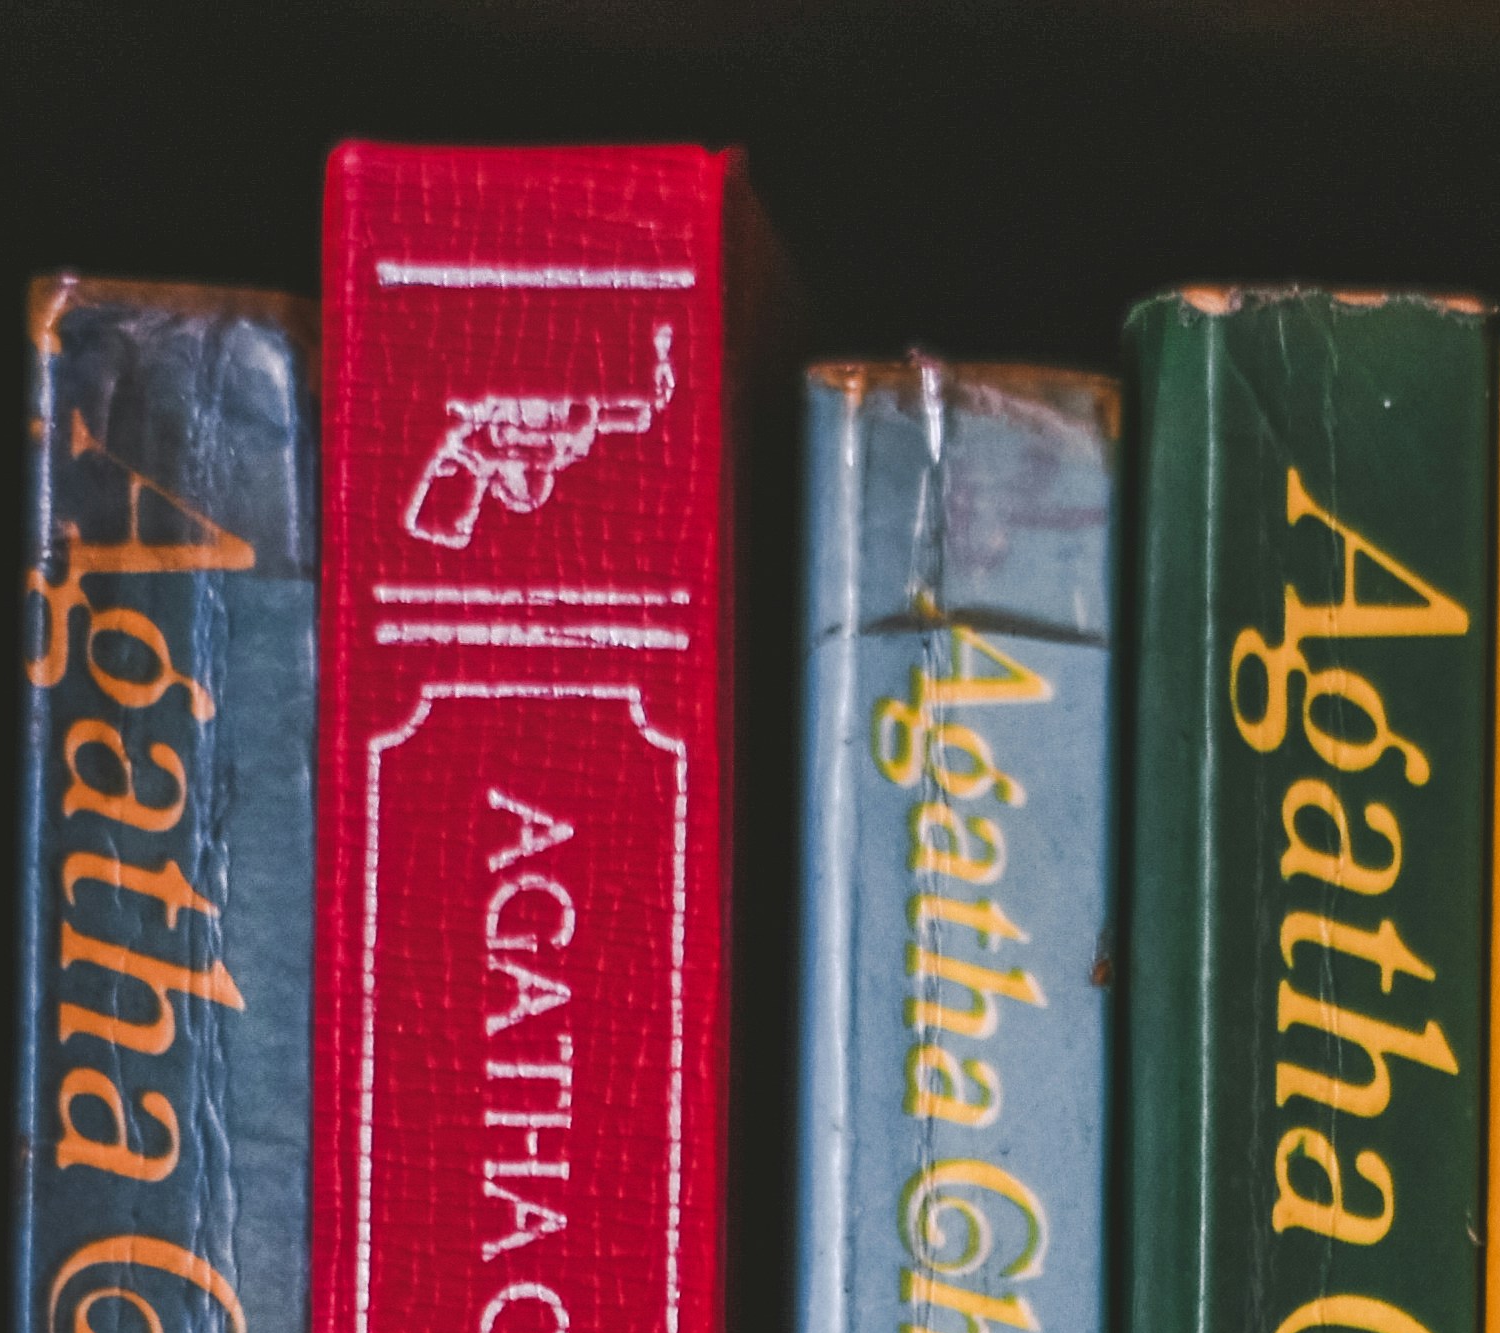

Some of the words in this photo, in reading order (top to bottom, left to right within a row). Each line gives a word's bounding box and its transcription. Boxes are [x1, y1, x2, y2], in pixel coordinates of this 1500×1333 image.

[25, 406, 256, 1181] Agatha
[485, 787, 577, 1263] AGATHA
[871, 588, 1055, 1128] Agatha
[1231, 465, 1469, 1247] Agatha
